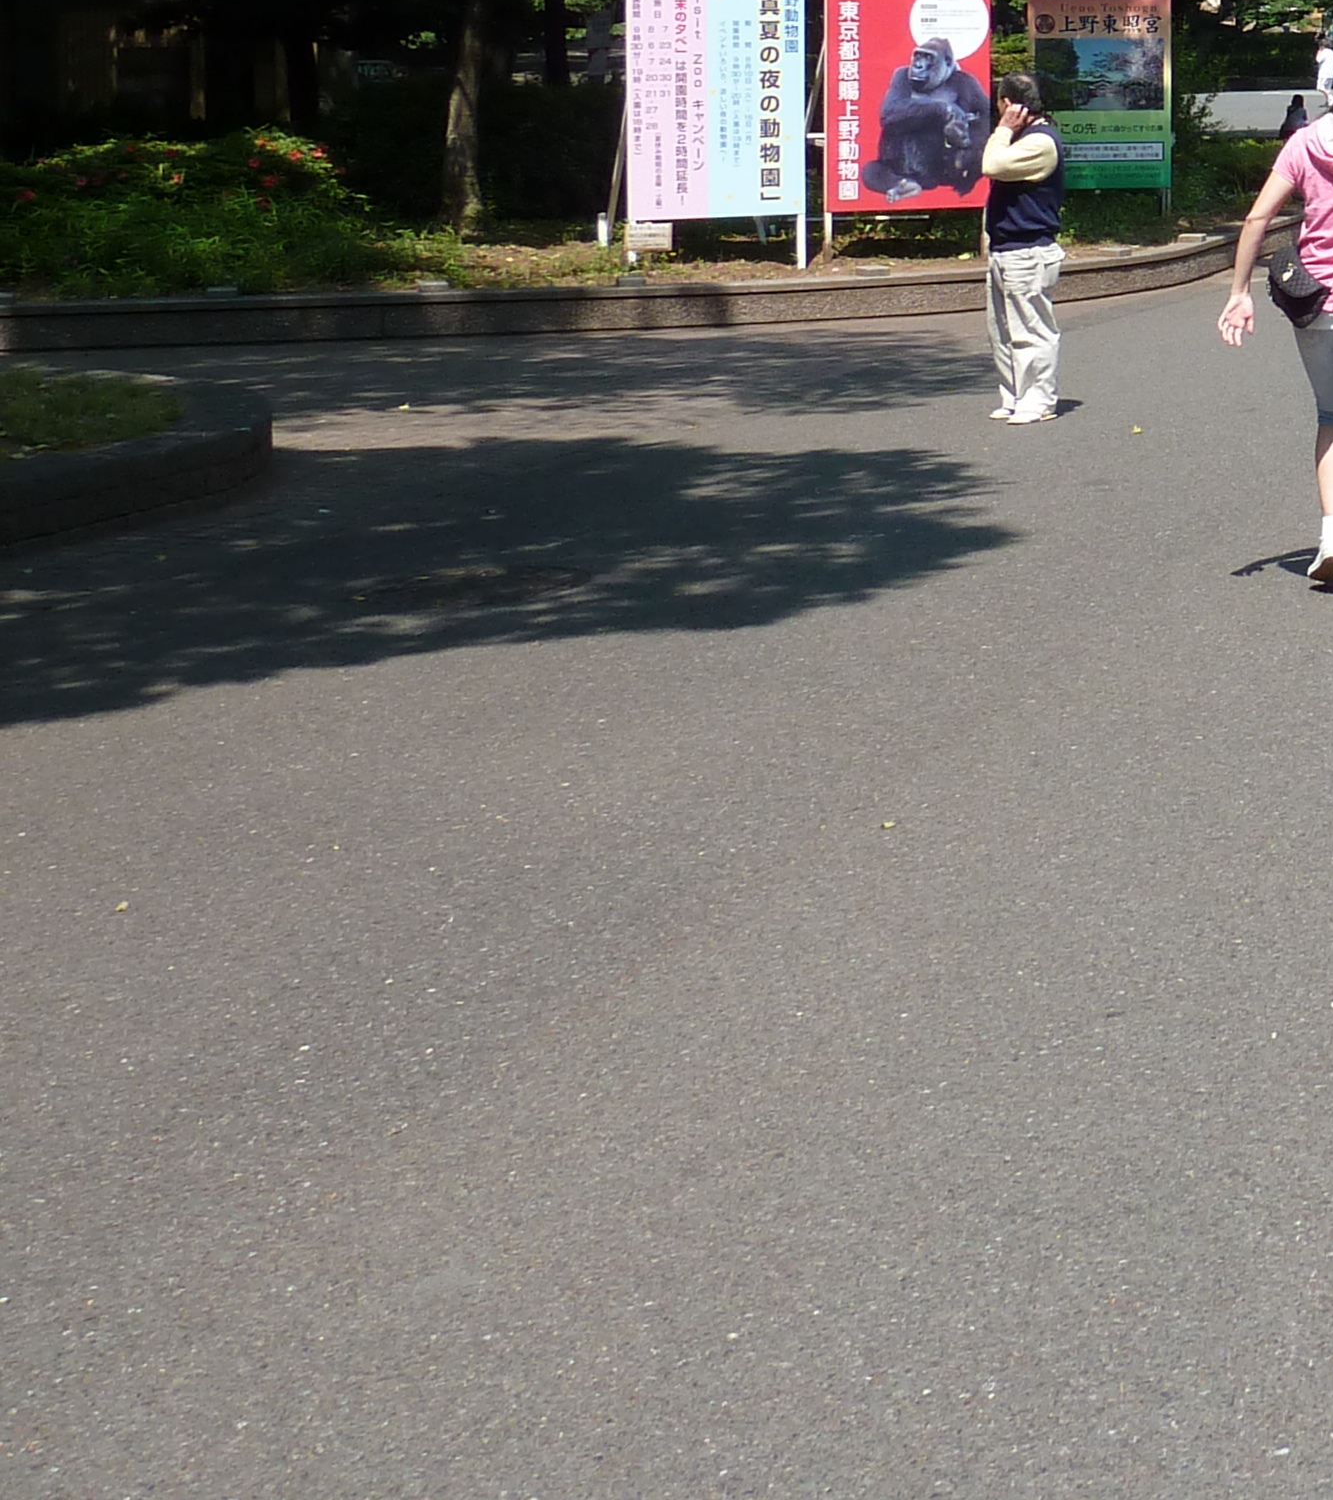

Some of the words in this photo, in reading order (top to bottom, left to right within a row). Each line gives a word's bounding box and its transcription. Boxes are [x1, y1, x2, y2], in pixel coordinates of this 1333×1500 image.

[1060, 3, 1095, 13] Ueno
[1058, 14, 1162, 34] 上野東照宮
[838, 0, 860, 200] 東京都恩賜上野動物園
[692, 100, 704, 171] キャンペーン
[1060, 123, 1097, 135] この先
